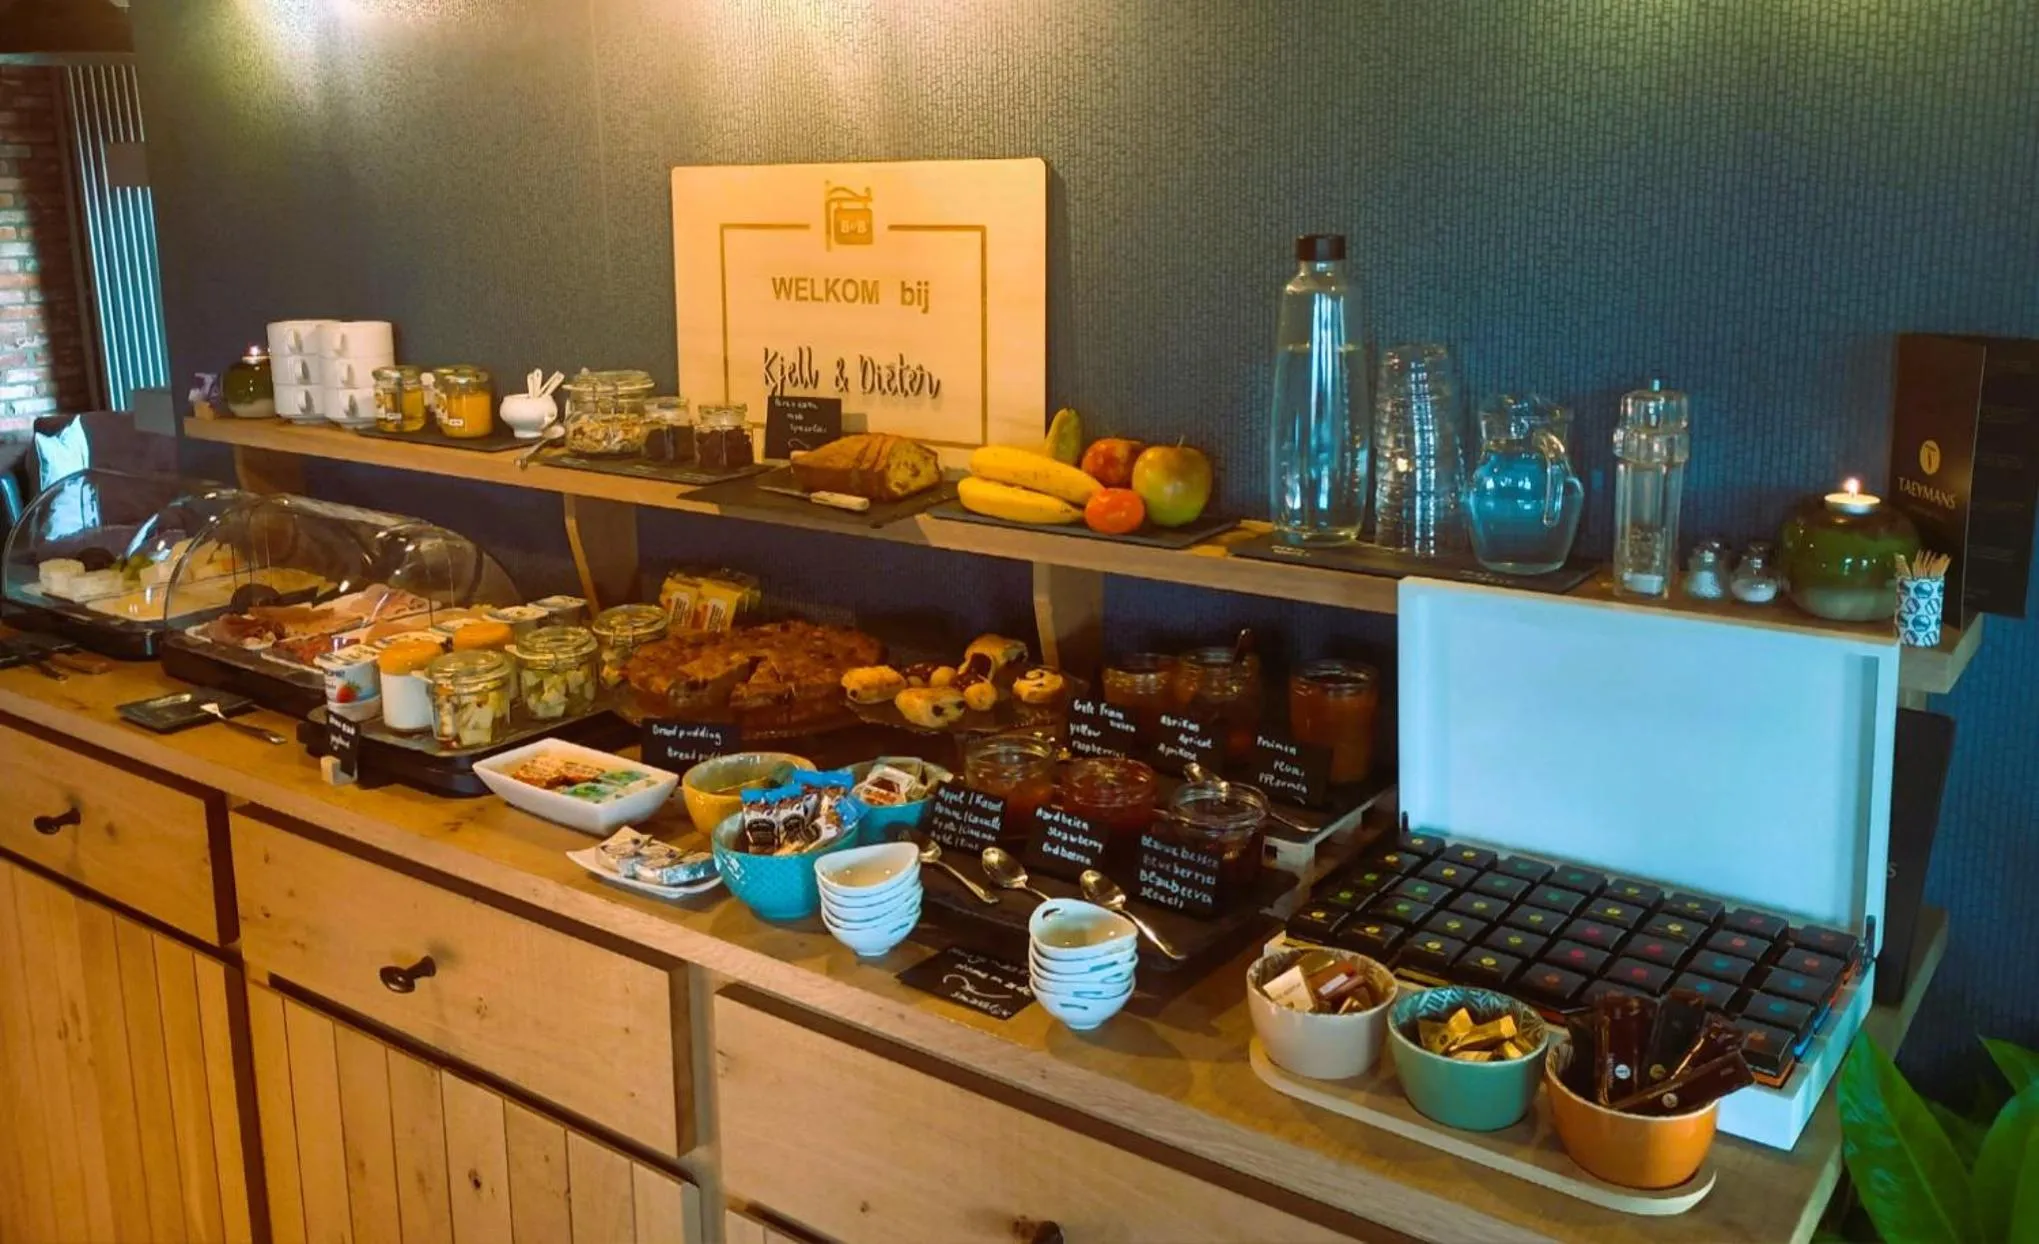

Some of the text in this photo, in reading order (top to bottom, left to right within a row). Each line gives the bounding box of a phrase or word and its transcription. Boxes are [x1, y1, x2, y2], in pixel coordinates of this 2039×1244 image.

[772, 276, 930, 315] WELKOM bij
[763, 346, 941, 399] Kjell & Dieter
[1898, 476, 1956, 510] TAEYMANS
